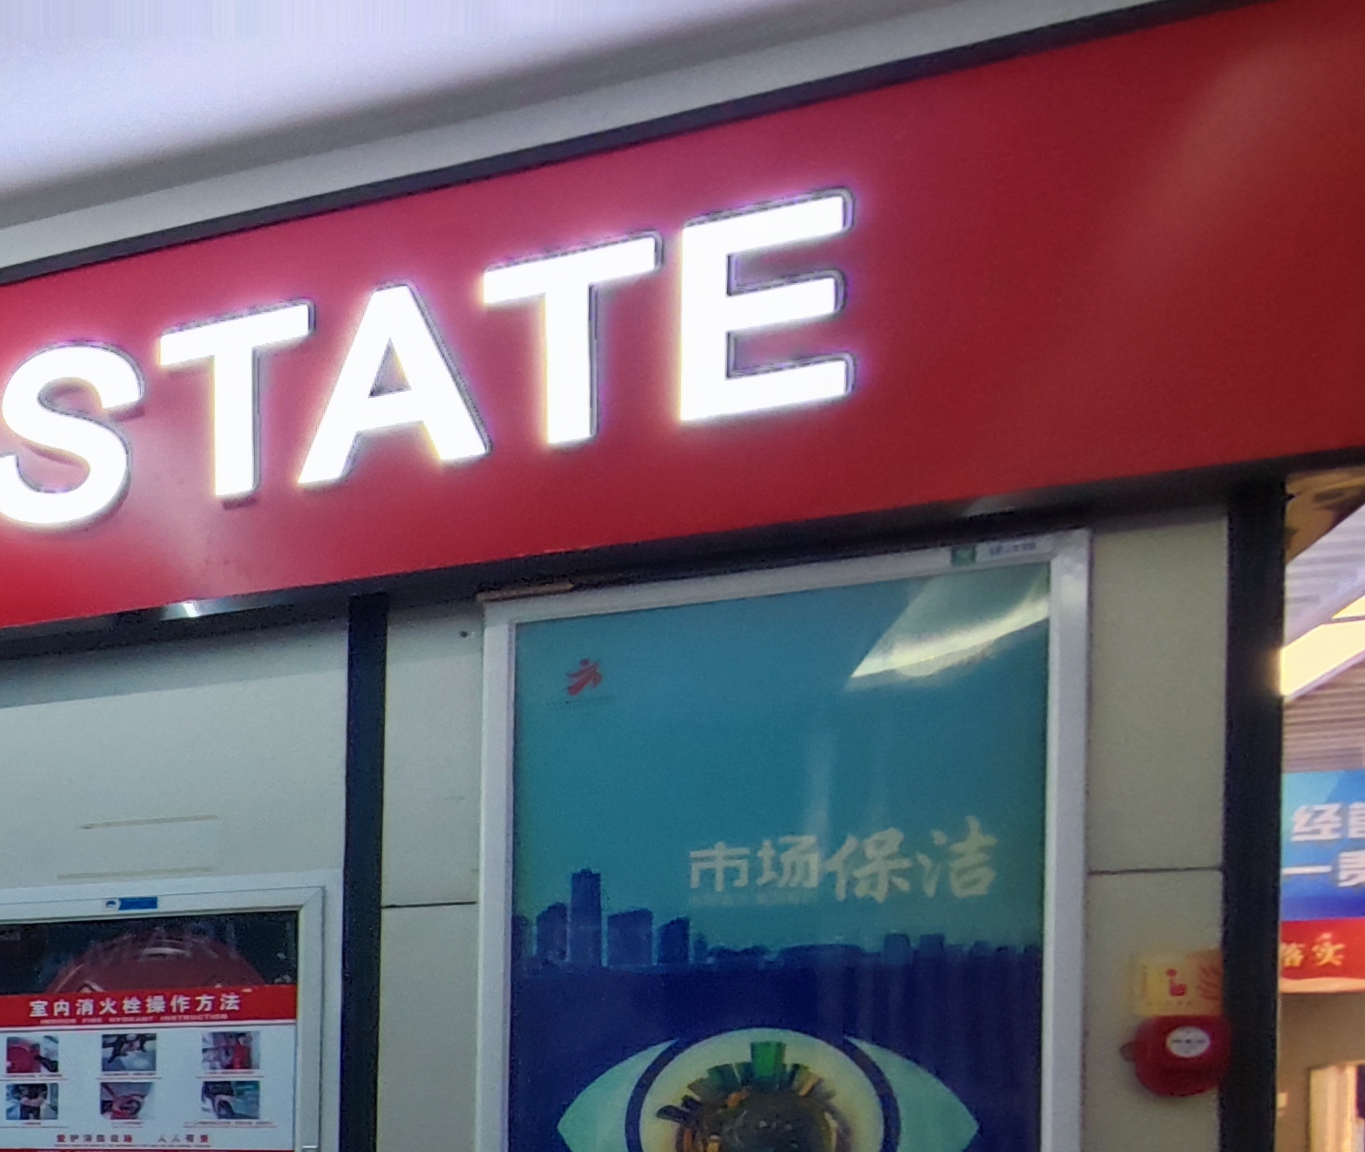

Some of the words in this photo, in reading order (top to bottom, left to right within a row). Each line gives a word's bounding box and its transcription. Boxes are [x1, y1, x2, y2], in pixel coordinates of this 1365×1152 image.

[689, 815, 998, 902] 市场保洁
[29, 992, 242, 1018] 室内消火栓操作方法
